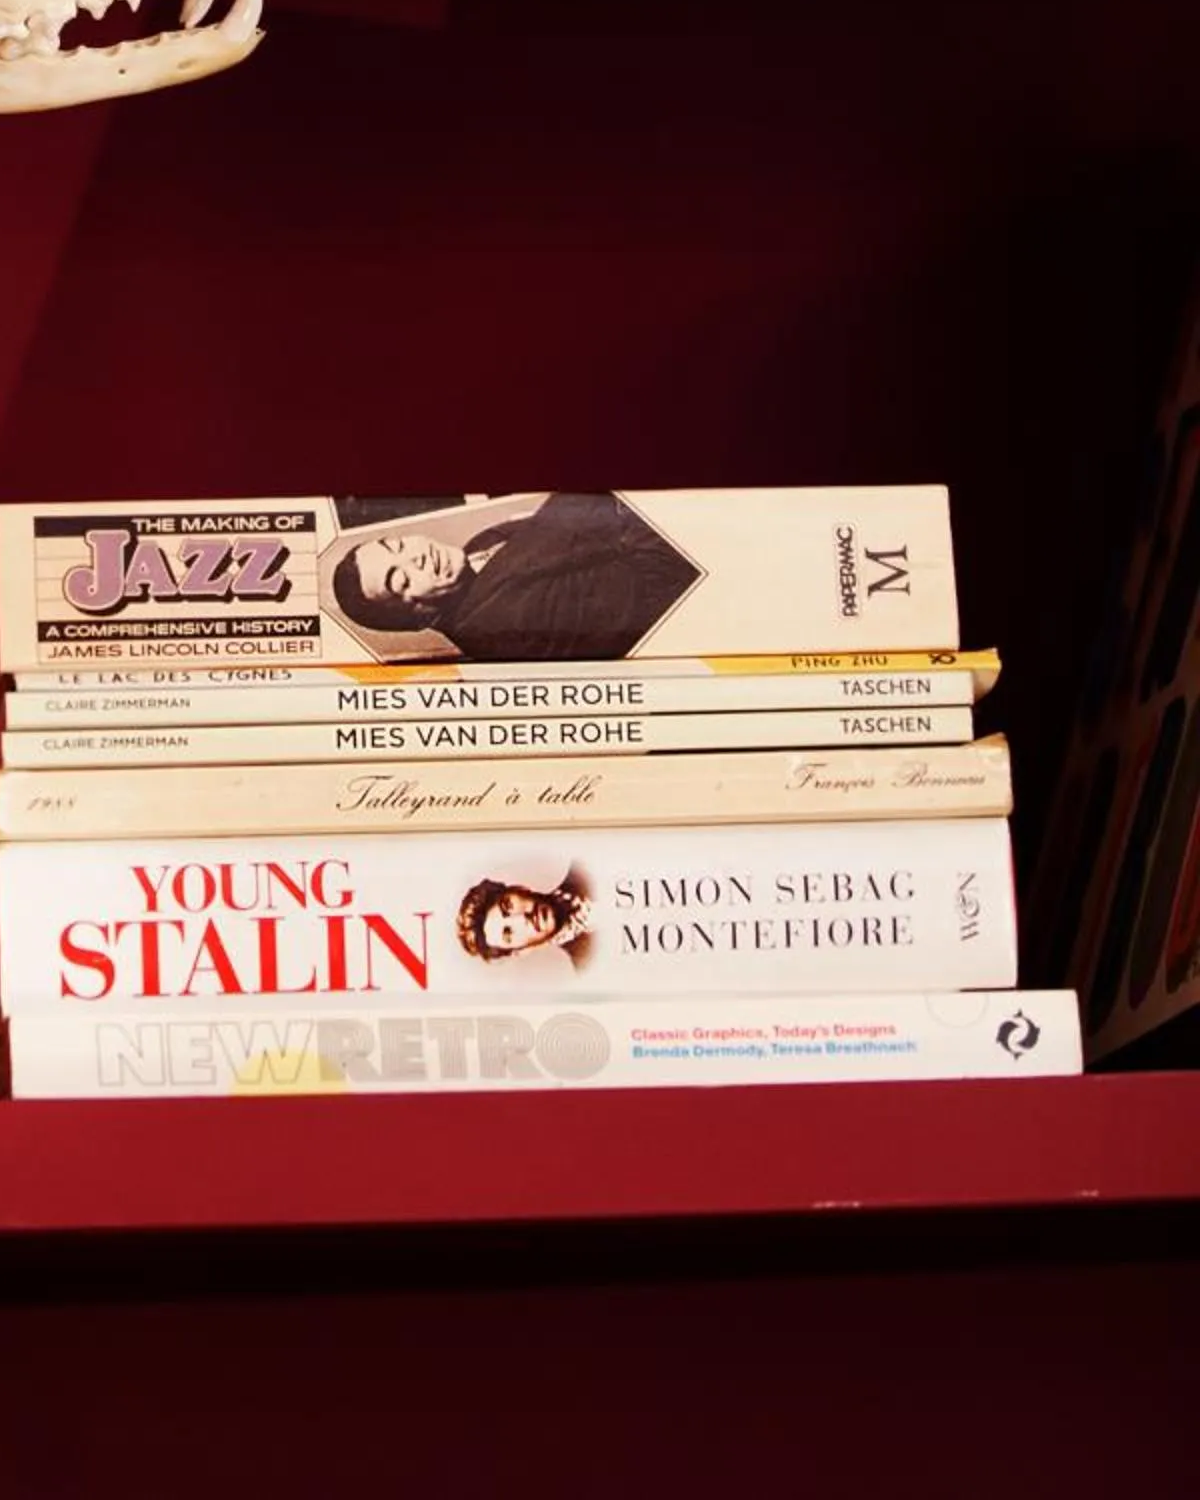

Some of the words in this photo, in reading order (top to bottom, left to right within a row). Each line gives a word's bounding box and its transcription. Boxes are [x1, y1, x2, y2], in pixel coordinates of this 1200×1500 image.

[132, 517, 176, 534] THE
[180, 515, 270, 533] MAKING
[275, 514, 305, 531] OF
[62, 528, 294, 617] JAZZ
[836, 526, 860, 618] PAPERMAC
[864, 544, 912, 598] M
[45, 626, 60, 639] A
[64, 621, 227, 638] COMPREHENSIVE
[233, 619, 315, 636] HISTORY
[47, 643, 123, 660] JAMES
[129, 641, 220, 658] LINCOLN
[225, 639, 315, 656] COLLIER
[45, 698, 97, 713] CLAIRE
[100, 696, 191, 712] ZIMMERMAN
[337, 687, 407, 712] MIES
[417, 686, 480, 709] VAN
[490, 684, 550, 708] DER
[561, 682, 645, 706] ROHE
[840, 677, 932, 697] TASCHEN
[42, 737, 96, 752] CLAIRE
[99, 734, 189, 750] ZIMMERMAN
[336, 726, 406, 750] MIES
[416, 724, 479, 748] VAN
[489, 722, 549, 746] DER
[559, 720, 644, 744] ROHE
[839, 715, 932, 735] TASCHEN
[336, 774, 498, 819] Talleyrand
[505, 785, 521, 806] à
[538, 774, 603, 806] table
[785, 762, 876, 795] François
[129, 858, 356, 914] YOUNG
[614, 874, 754, 911] SIMON
[775, 869, 916, 903] SEBAG
[58, 911, 434, 1000] STALIN
[621, 914, 916, 956] MONTEFIORE
[631, 1028, 688, 1042] Classic
[693, 1025, 769, 1042] Graphics,
[772, 1025, 830, 1041] Today's
[834, 1023, 897, 1039] Designs
[632, 1044, 689, 1059] Brenda
[693, 1043, 768, 1060] Dermody,
[771, 1042, 823, 1057] Teresa
[826, 1040, 918, 1056] Breathnach
